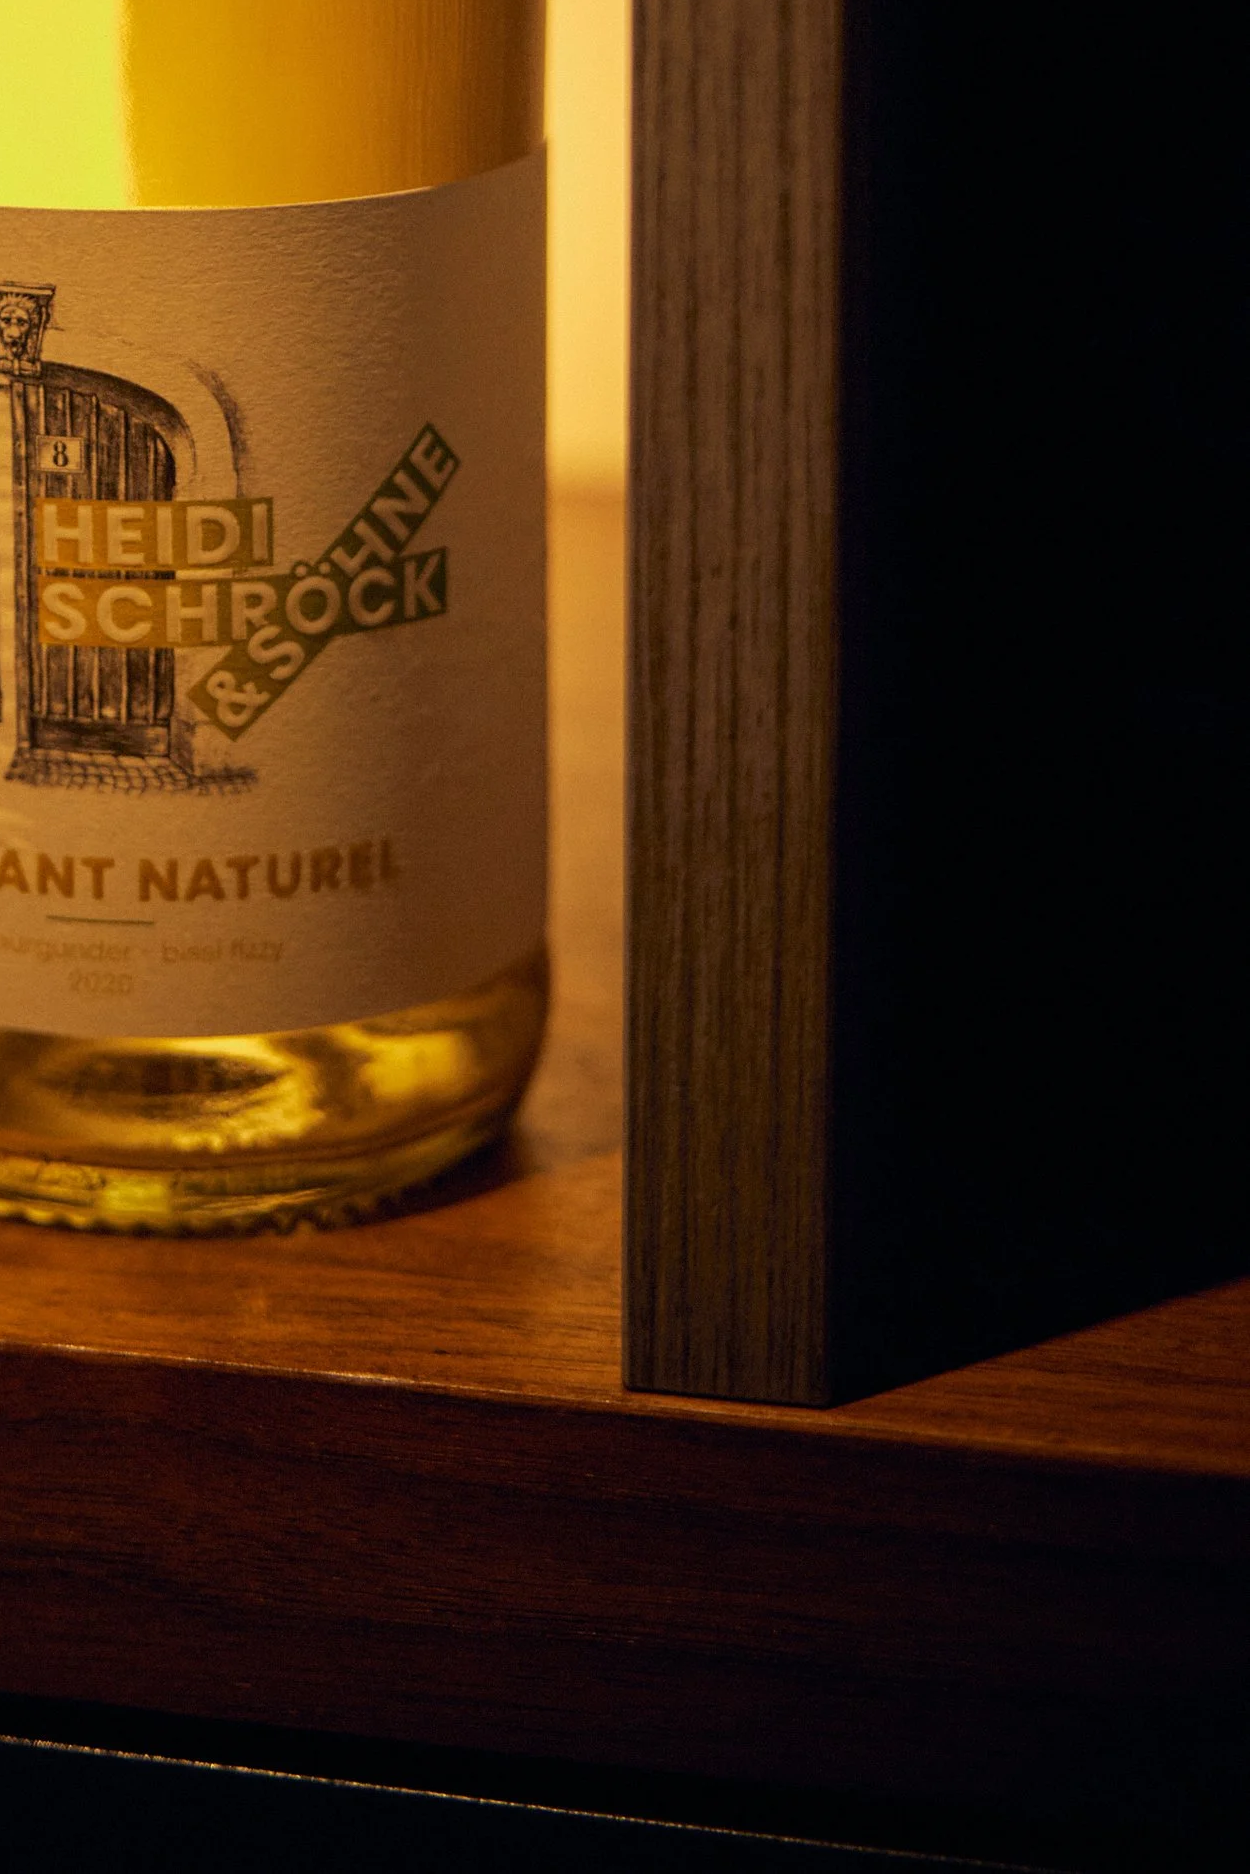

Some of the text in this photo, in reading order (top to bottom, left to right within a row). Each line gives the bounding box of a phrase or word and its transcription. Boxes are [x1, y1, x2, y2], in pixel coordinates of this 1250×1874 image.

[51, 440, 70, 468] 8
[42, 502, 269, 567] HEIDI
[41, 556, 444, 643] SCHRÖCK
[205, 430, 454, 728] & SÖHNE
[137, 836, 400, 904] NATUREL
